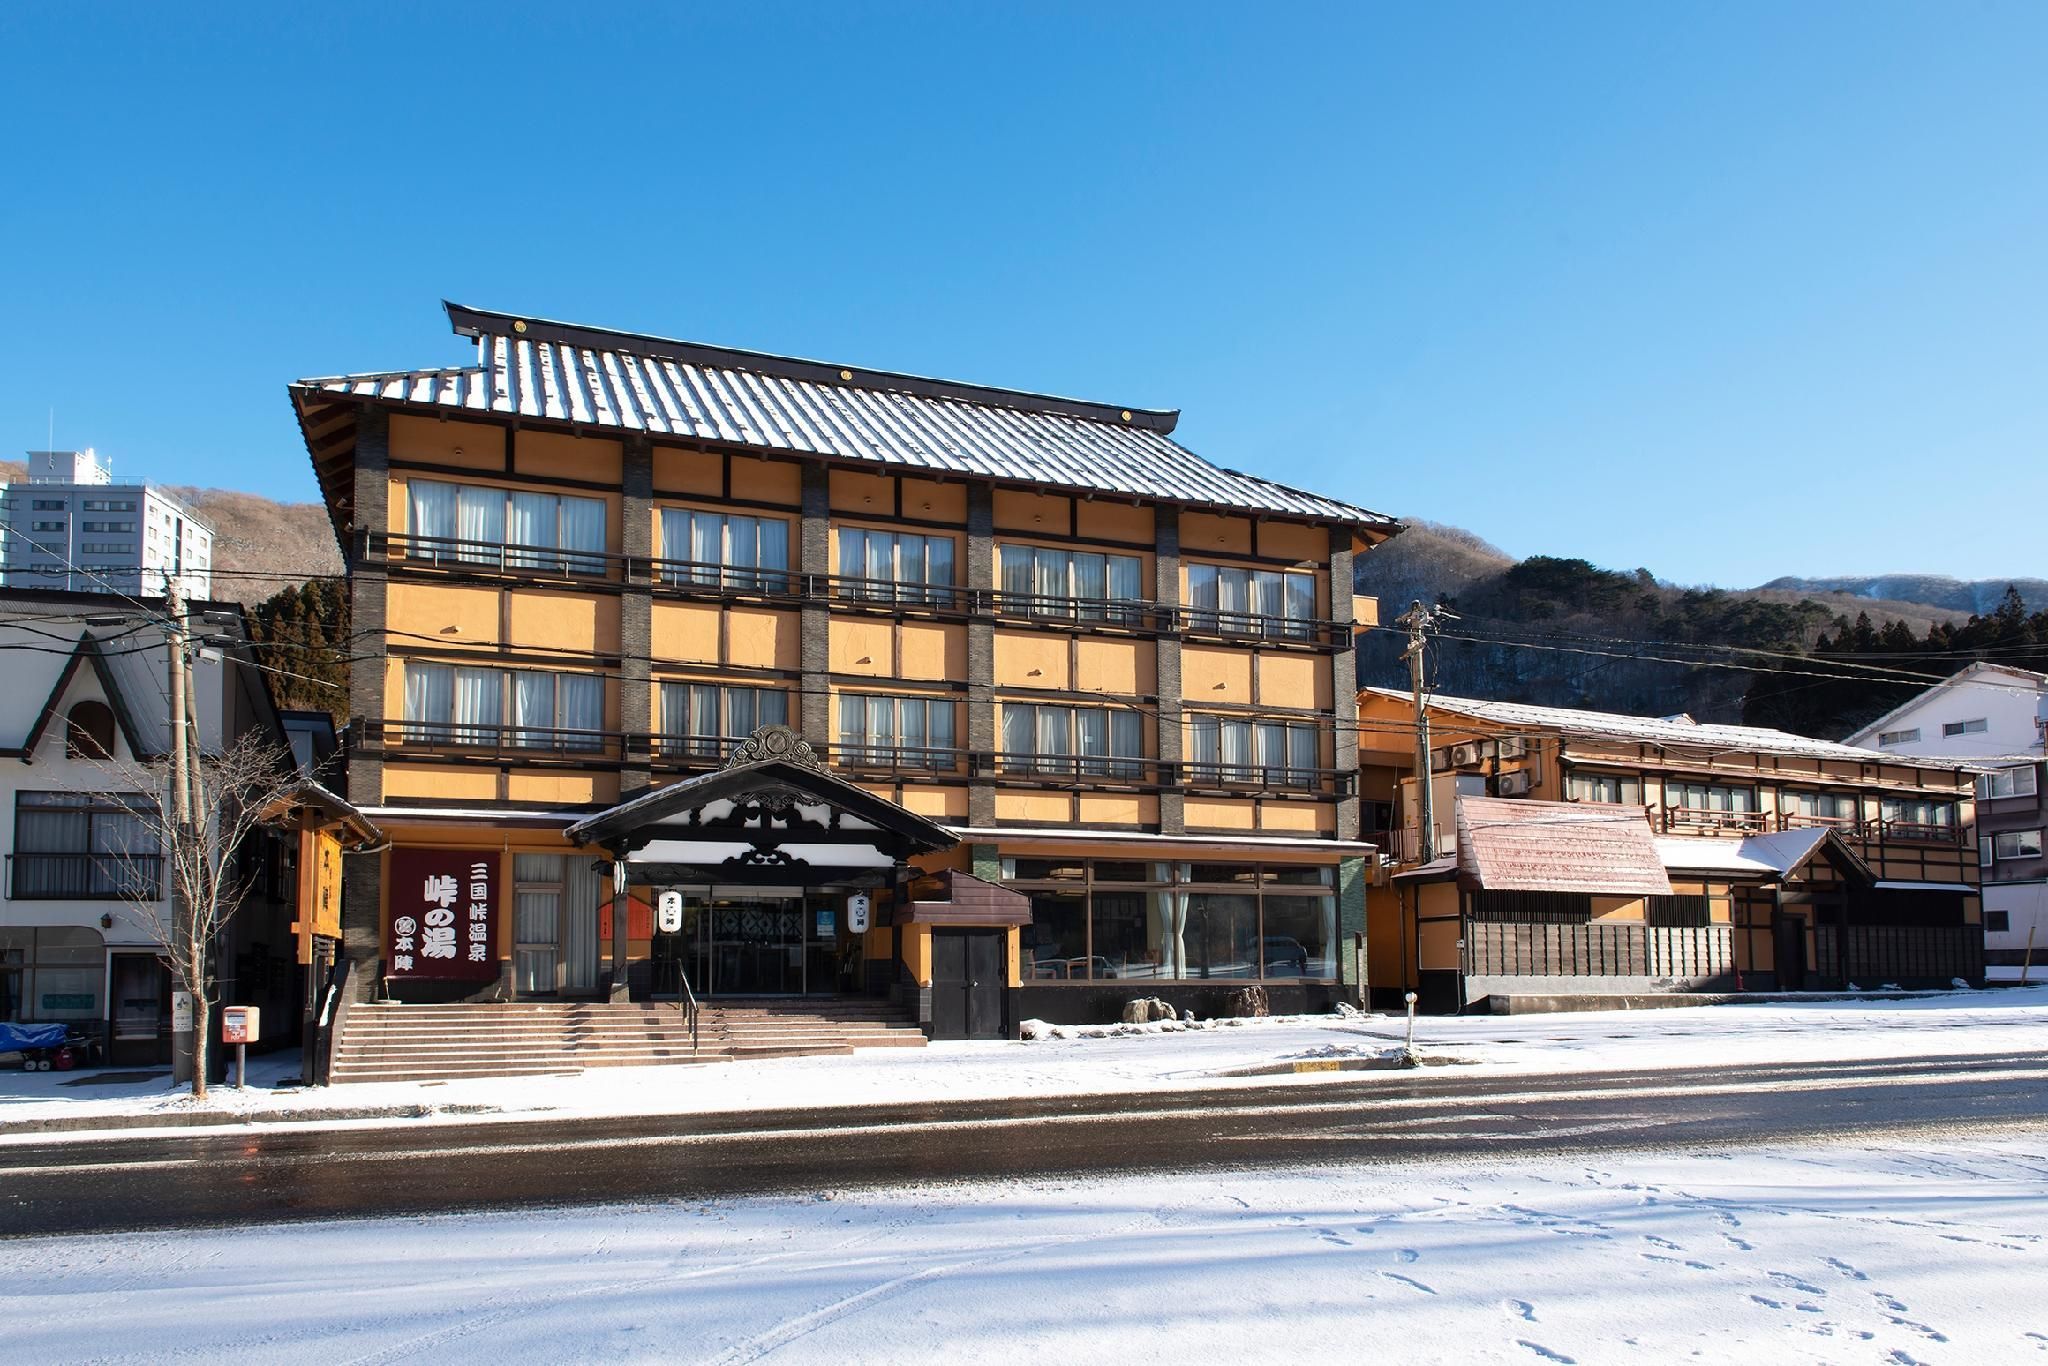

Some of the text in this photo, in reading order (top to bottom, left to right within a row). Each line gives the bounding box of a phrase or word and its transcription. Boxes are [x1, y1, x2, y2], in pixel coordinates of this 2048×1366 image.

[394, 936, 414, 971] 本陣
[420, 875, 458, 959] 峠の湯
[468, 862, 488, 962] 三国峠温泉
